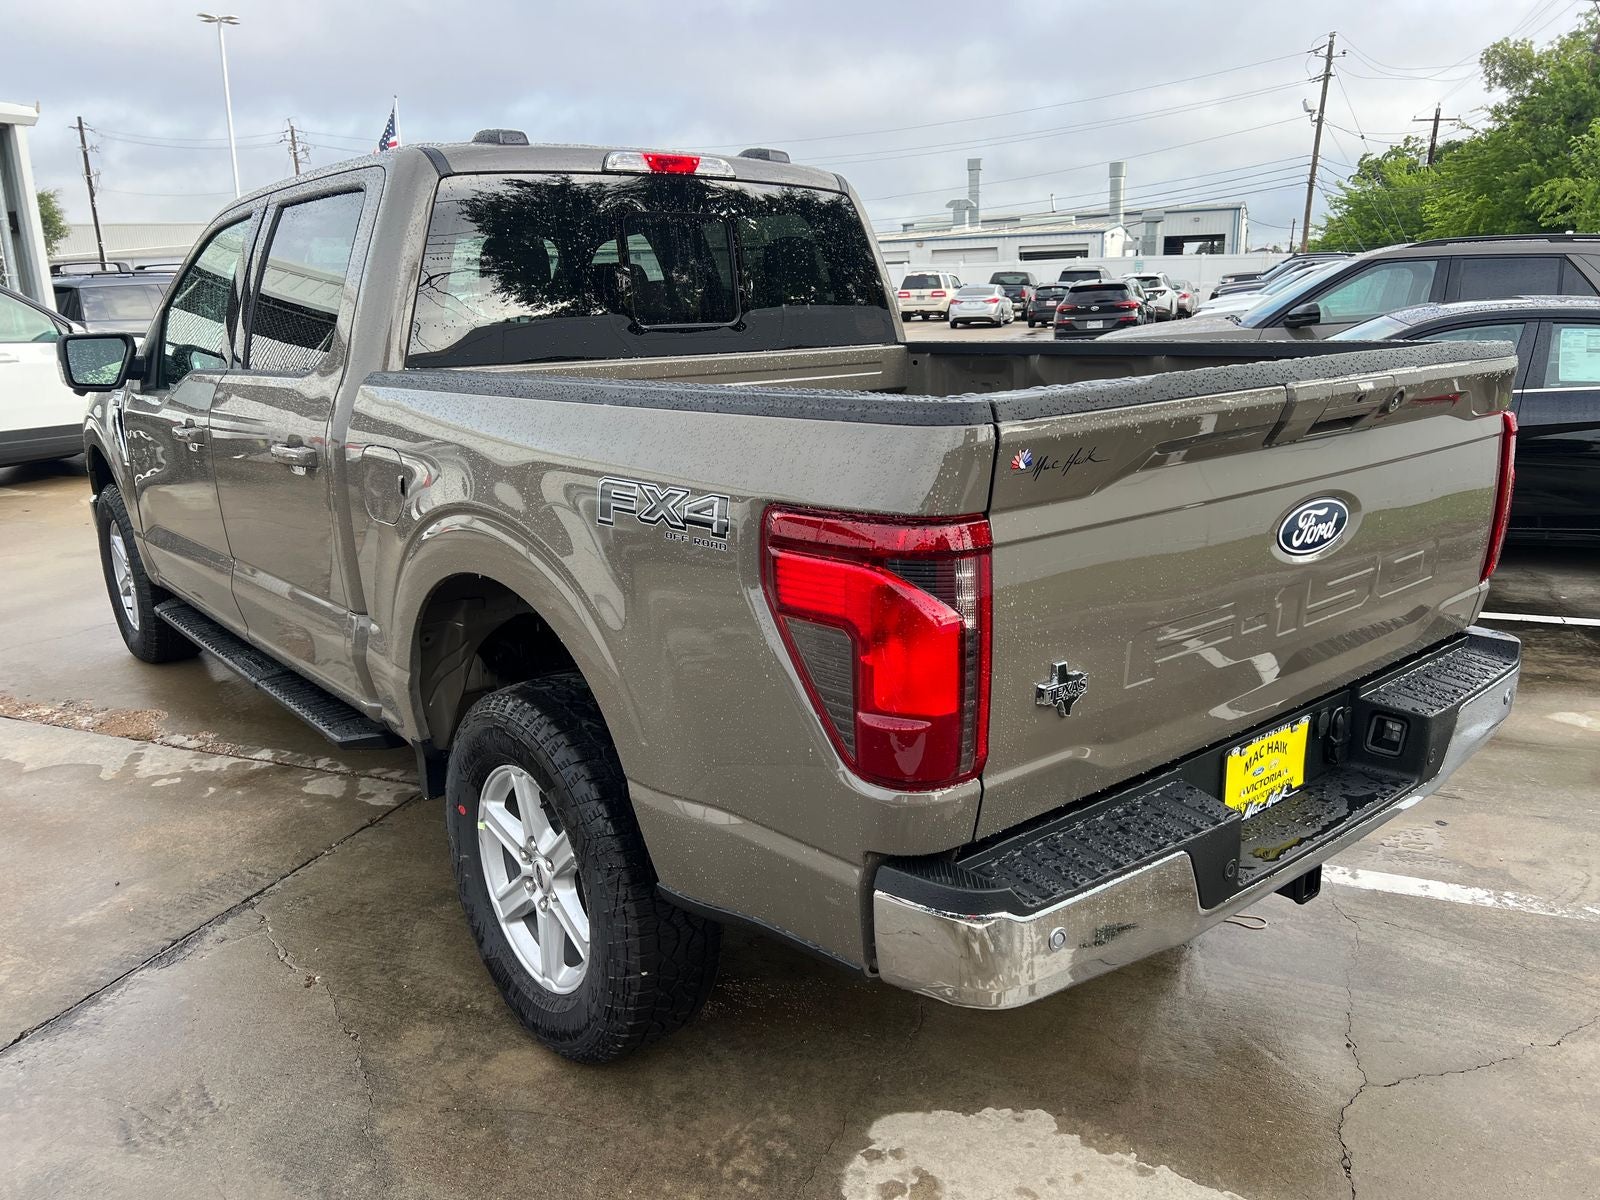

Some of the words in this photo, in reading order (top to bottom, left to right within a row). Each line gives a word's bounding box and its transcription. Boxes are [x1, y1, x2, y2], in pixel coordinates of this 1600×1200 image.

[597, 475, 731, 540] FX4
[665, 531, 690, 542] OFF
[693, 537, 728, 551] ROAD
[1292, 507, 1339, 547] Ford
[1123, 537, 1440, 690] F-150
[1046, 678, 1087, 703] TEXAS
[1244, 744, 1265, 776] MAC
[1267, 740, 1288, 755] HAIK
[1245, 769, 1282, 795] VICTORIA
